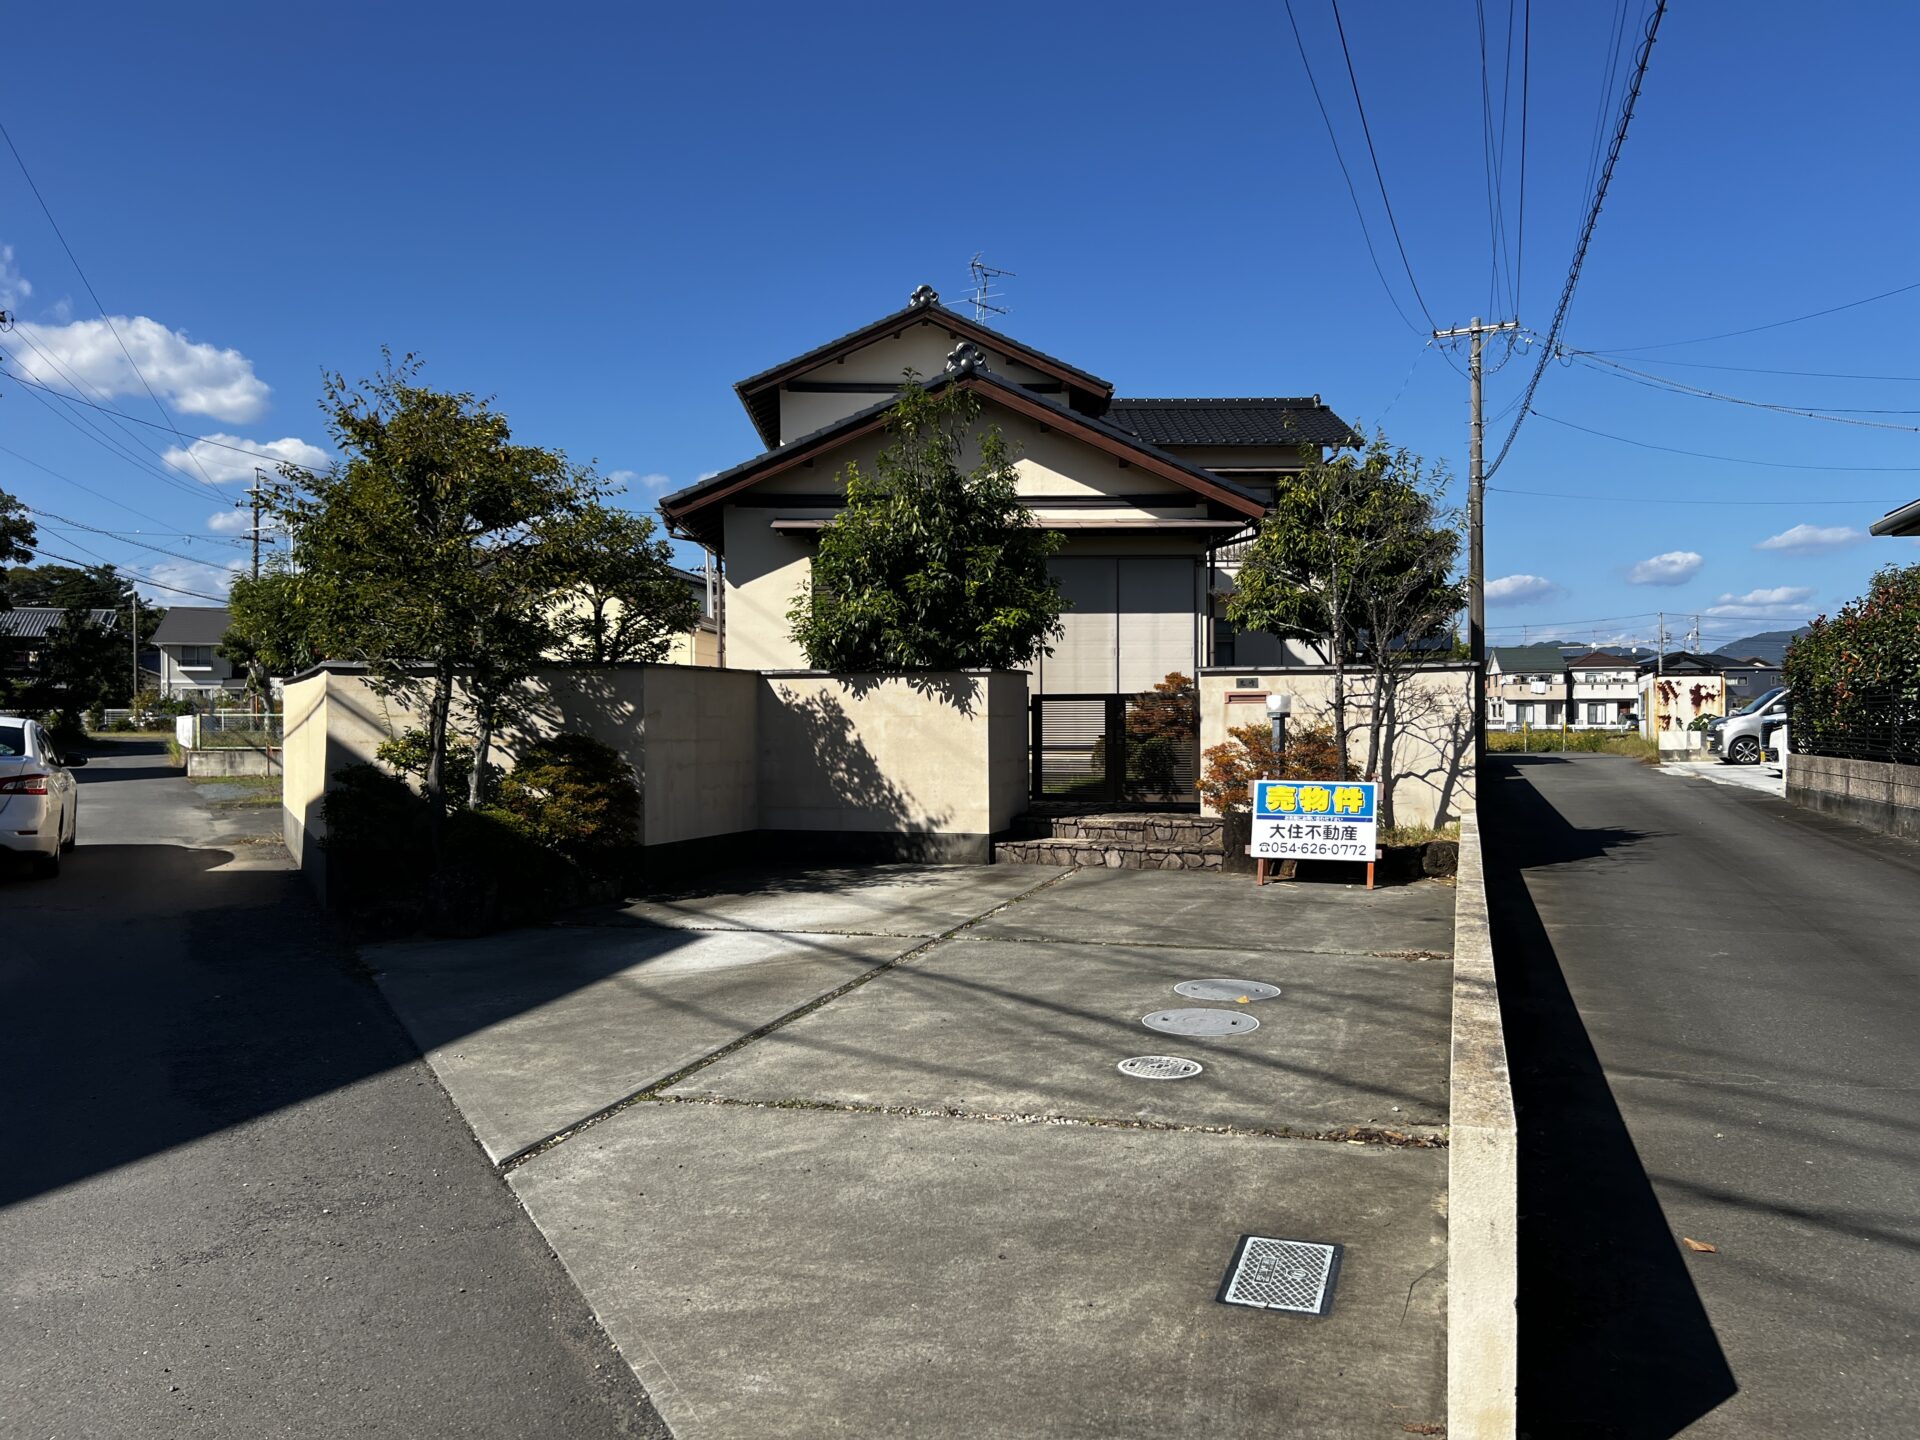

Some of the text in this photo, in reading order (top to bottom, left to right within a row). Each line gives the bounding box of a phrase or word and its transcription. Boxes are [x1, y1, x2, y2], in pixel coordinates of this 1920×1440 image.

[1266, 785, 1365, 813] 売物件
[1269, 824, 1358, 841] 大住不動産
